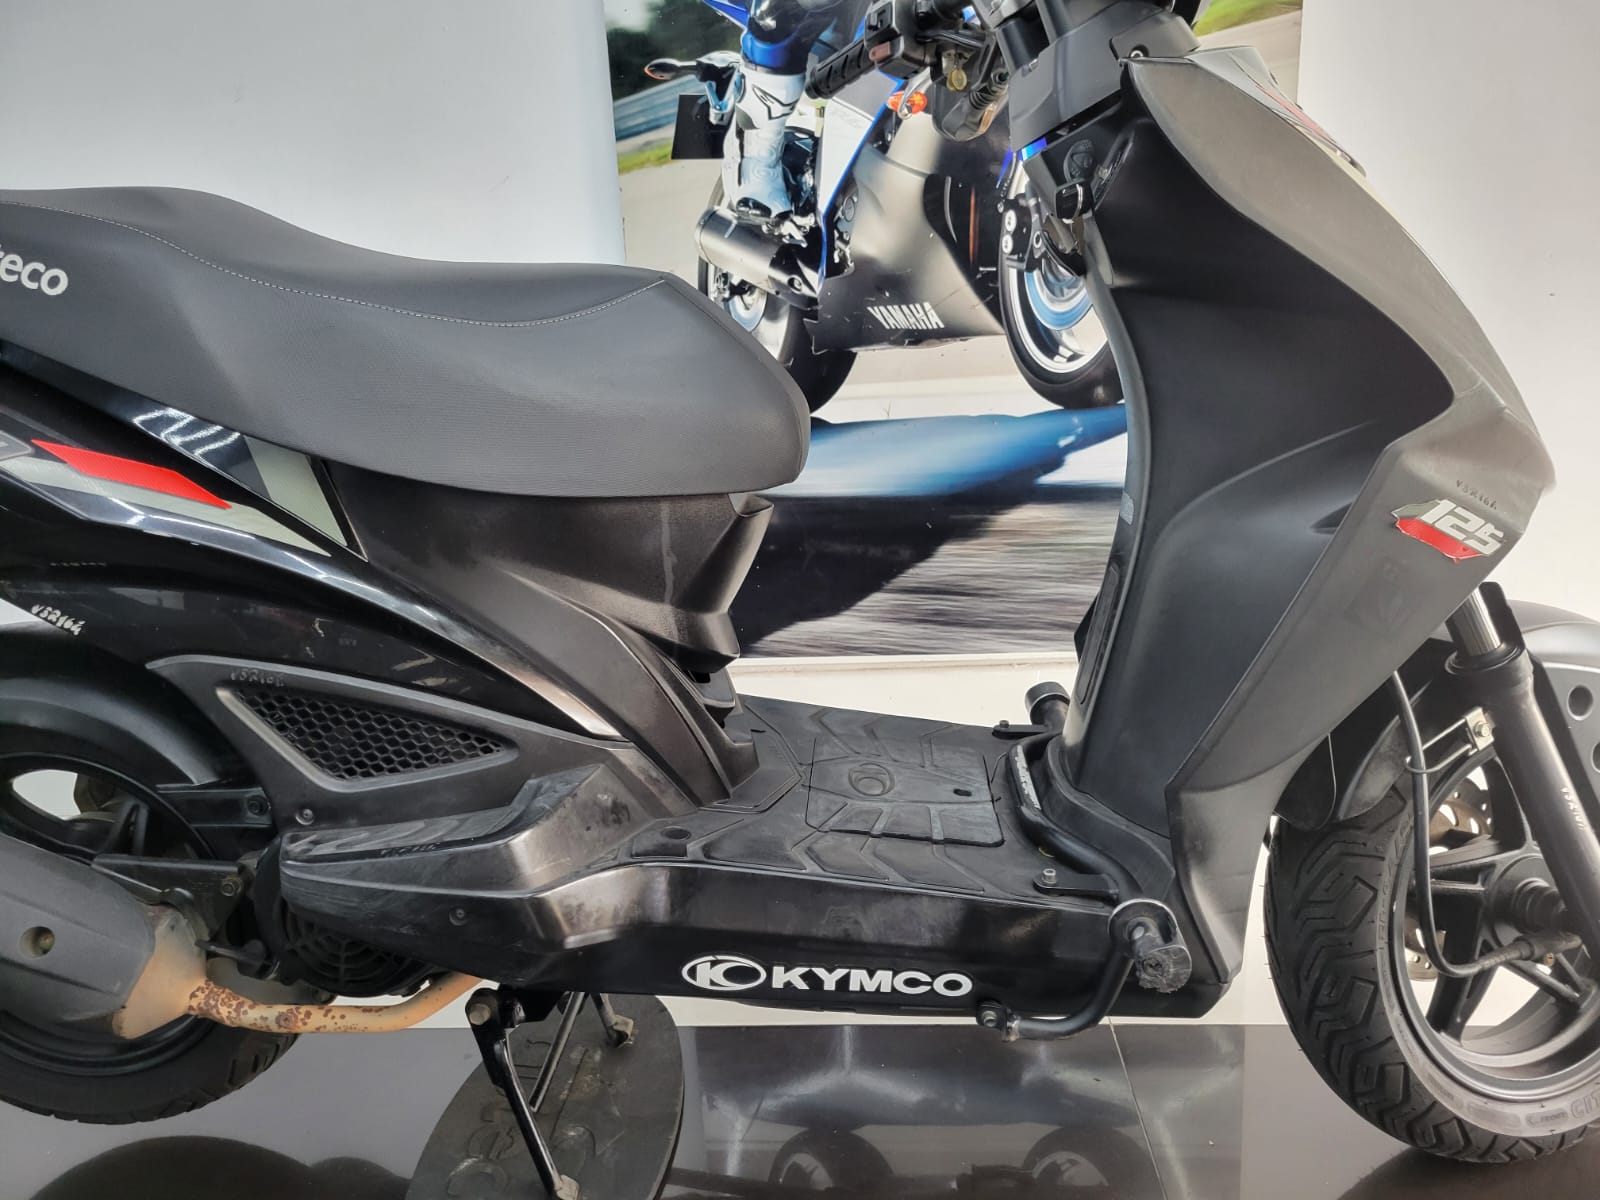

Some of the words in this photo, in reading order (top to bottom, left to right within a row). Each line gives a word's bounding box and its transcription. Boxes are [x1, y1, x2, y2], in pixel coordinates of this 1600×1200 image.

[866, 301, 945, 330] YAMAHA
[1420, 499, 1504, 555] 125
[771, 965, 973, 997] KYMCO
